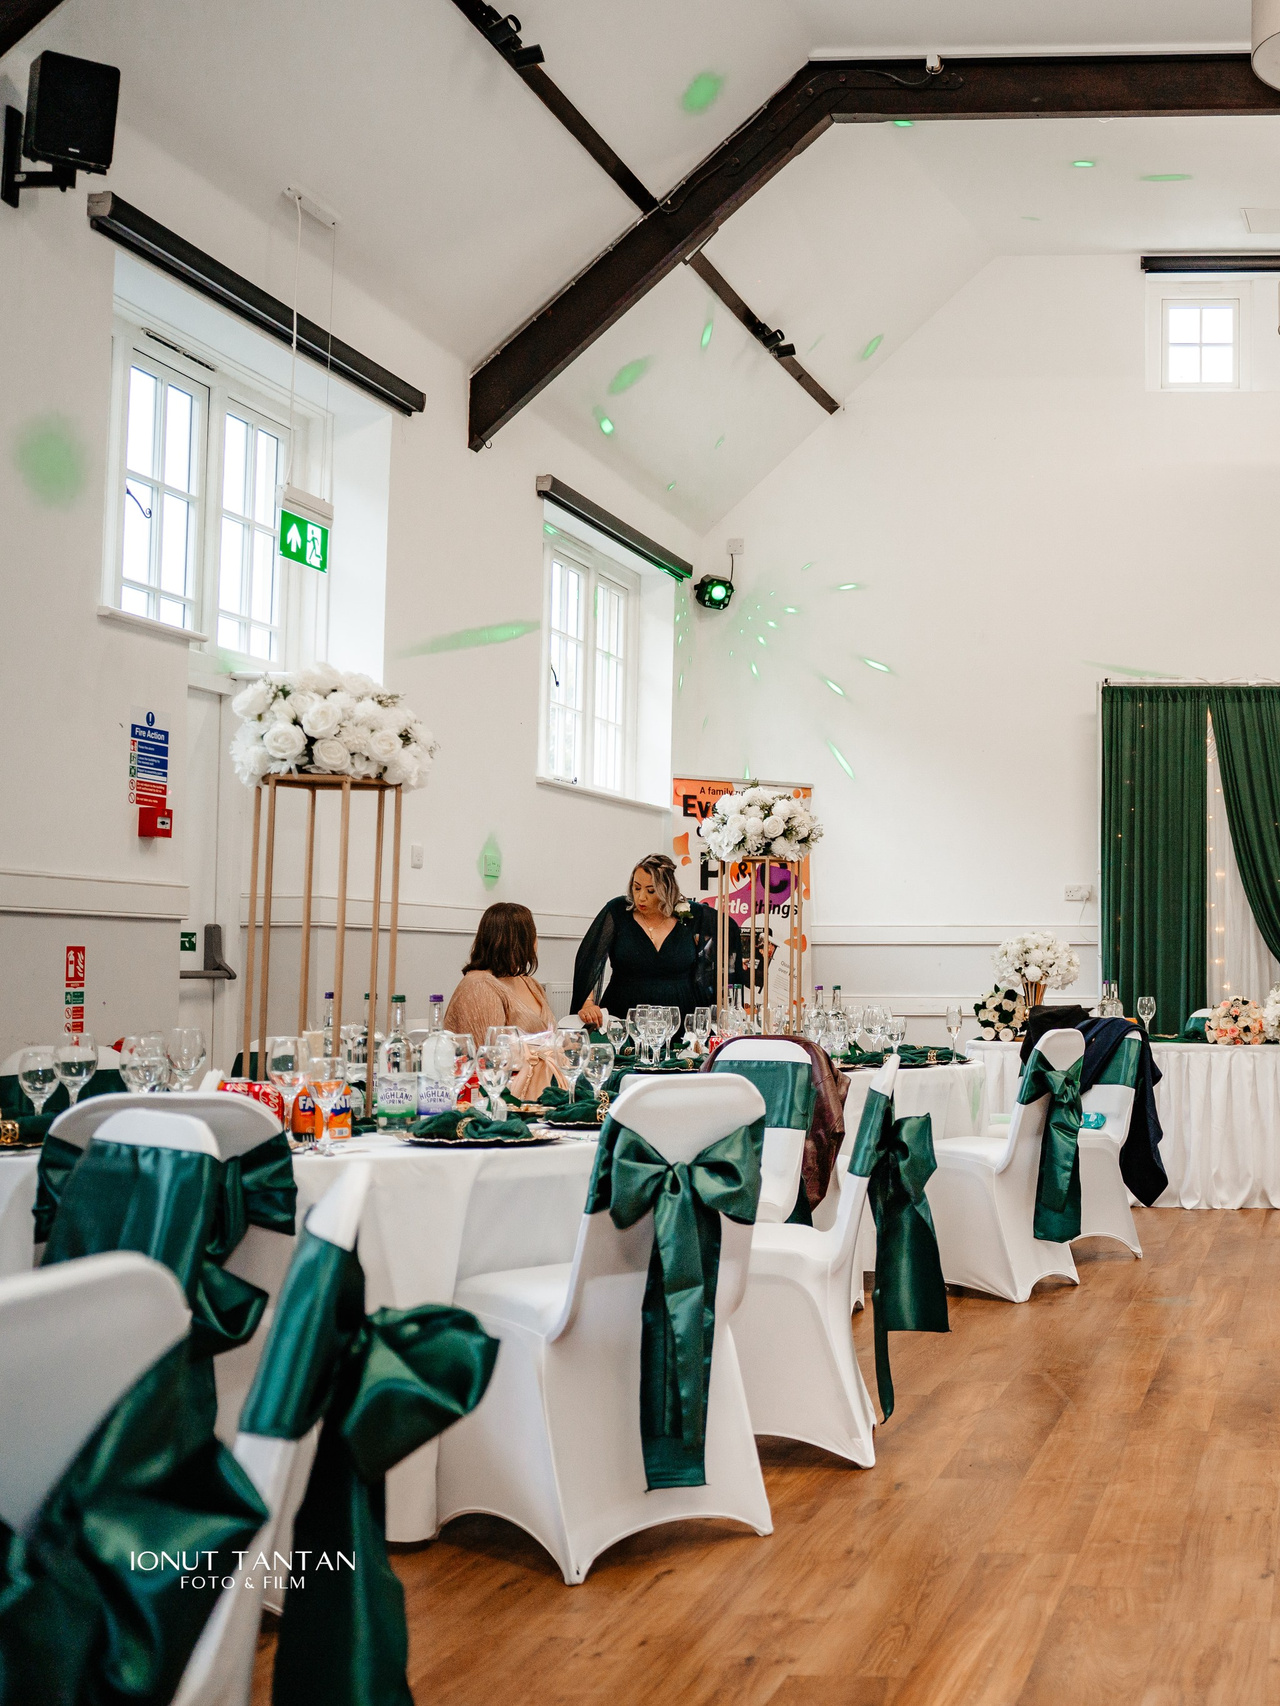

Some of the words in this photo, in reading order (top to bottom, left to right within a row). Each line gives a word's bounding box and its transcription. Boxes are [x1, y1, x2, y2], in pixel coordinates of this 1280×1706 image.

[135, 727, 146, 738] Fire
[147, 730, 165, 741] Action
[700, 787, 706, 795] A
[708, 787, 733, 796] family
[379, 1091, 412, 1102] HIGHLAND
